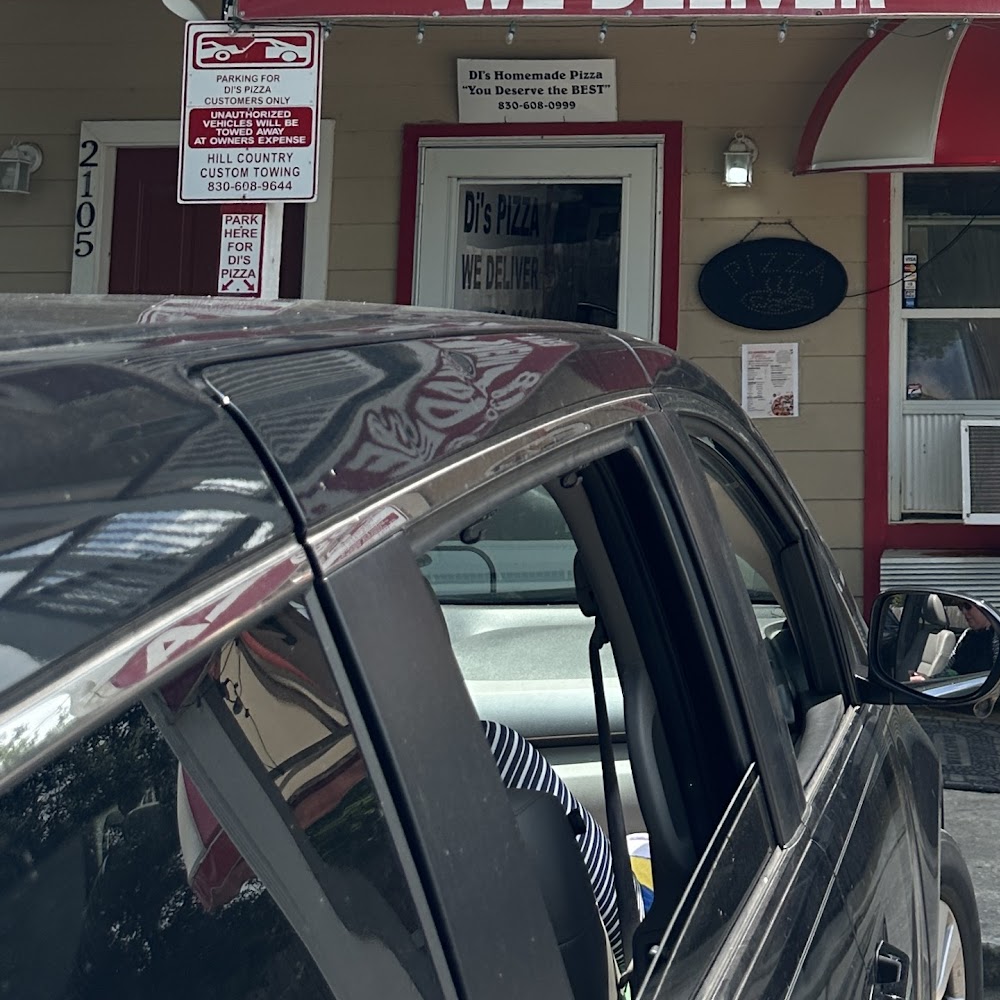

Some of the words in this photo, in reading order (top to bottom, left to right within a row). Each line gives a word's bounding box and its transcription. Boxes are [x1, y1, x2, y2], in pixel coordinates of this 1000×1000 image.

[216, 74, 259, 83] PARKING
[260, 74, 281, 83] FOR
[493, 70, 567, 80] Homemade
[569, 70, 603, 80] Pizza
[224, 85, 242, 94] DI'S
[244, 85, 272, 94] PIZZA
[495, 85, 545, 95] Deserve
[547, 85, 568, 95] the
[571, 84, 611, 95] BEST"
[204, 96, 264, 105] CUSTOMERS
[265, 96, 291, 105] ONLY
[497, 101, 577, 110] 830-608-0999
[210, 110, 292, 119] UNAUTHORIZED
[202, 119, 253, 128] VEHICLES
[255, 119, 282, 127] WILL
[284, 118, 299, 127] BE
[215, 128, 253, 136] TOWED
[255, 127, 285, 136] AWAY
[193, 136, 207, 145] AT
[209, 136, 255, 145] OWNERS
[257, 135, 307, 145] EXPENSE
[207, 153, 233, 164] HILL
[237, 152, 294, 164] COUNTRY
[200, 167, 249, 178] CUSTOM
[253, 166, 301, 178] TOWING
[207, 180, 293, 192] 830-608-9644
[75, 140, 98, 257] 2105
[463, 190, 492, 235] Di's
[496, 193, 540, 237] PIZZA
[224, 215, 259, 225] PARK
[224, 228, 258, 239] HERE
[227, 242, 253, 252] FOR
[227, 255, 251, 265] DI'S
[221, 268, 256, 279] PIZZA
[462, 253, 482, 290] WE
[485, 255, 539, 290] DELIVER
